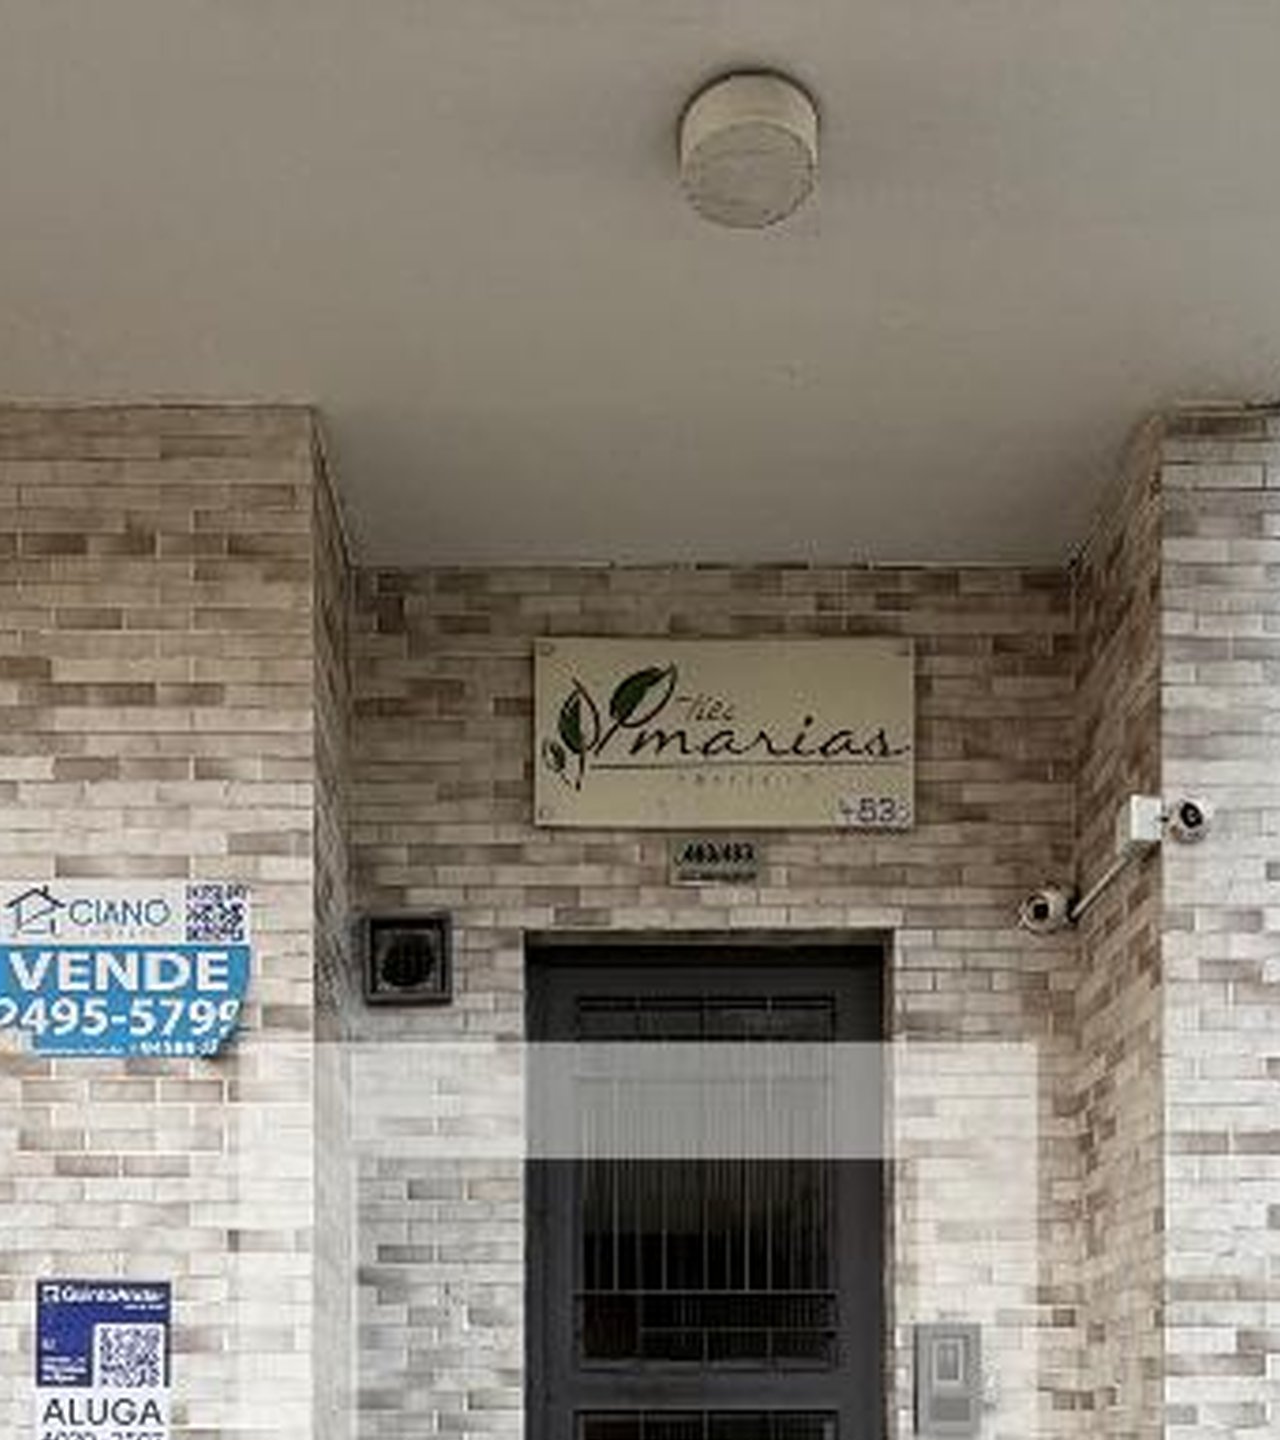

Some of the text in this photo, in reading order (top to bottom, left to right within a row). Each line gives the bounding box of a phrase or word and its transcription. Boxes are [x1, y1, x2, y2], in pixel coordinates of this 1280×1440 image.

[69, 899, 171, 926] CIANO
[9, 951, 229, 991] VENDE
[42, 1398, 164, 1426] ALUGA
